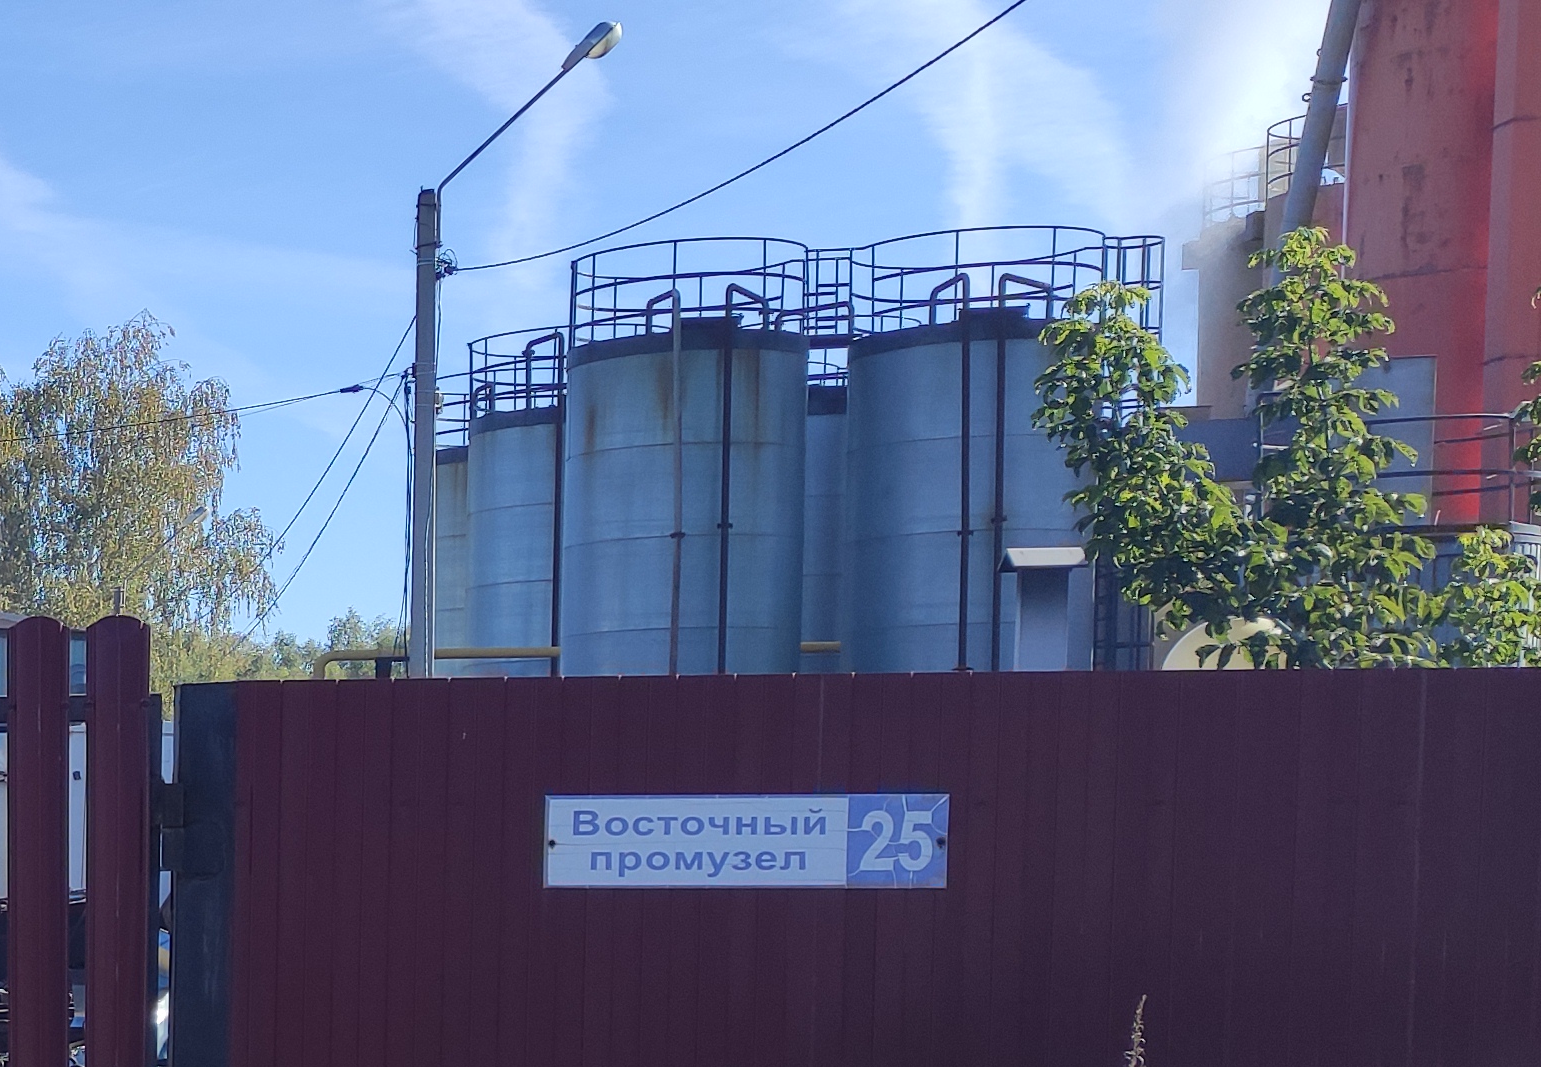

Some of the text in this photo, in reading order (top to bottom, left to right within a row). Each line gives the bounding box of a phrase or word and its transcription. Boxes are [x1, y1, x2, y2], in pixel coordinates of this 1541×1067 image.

[572, 808, 934, 872] Восточный 25
[590, 850, 807, 877] промузел
